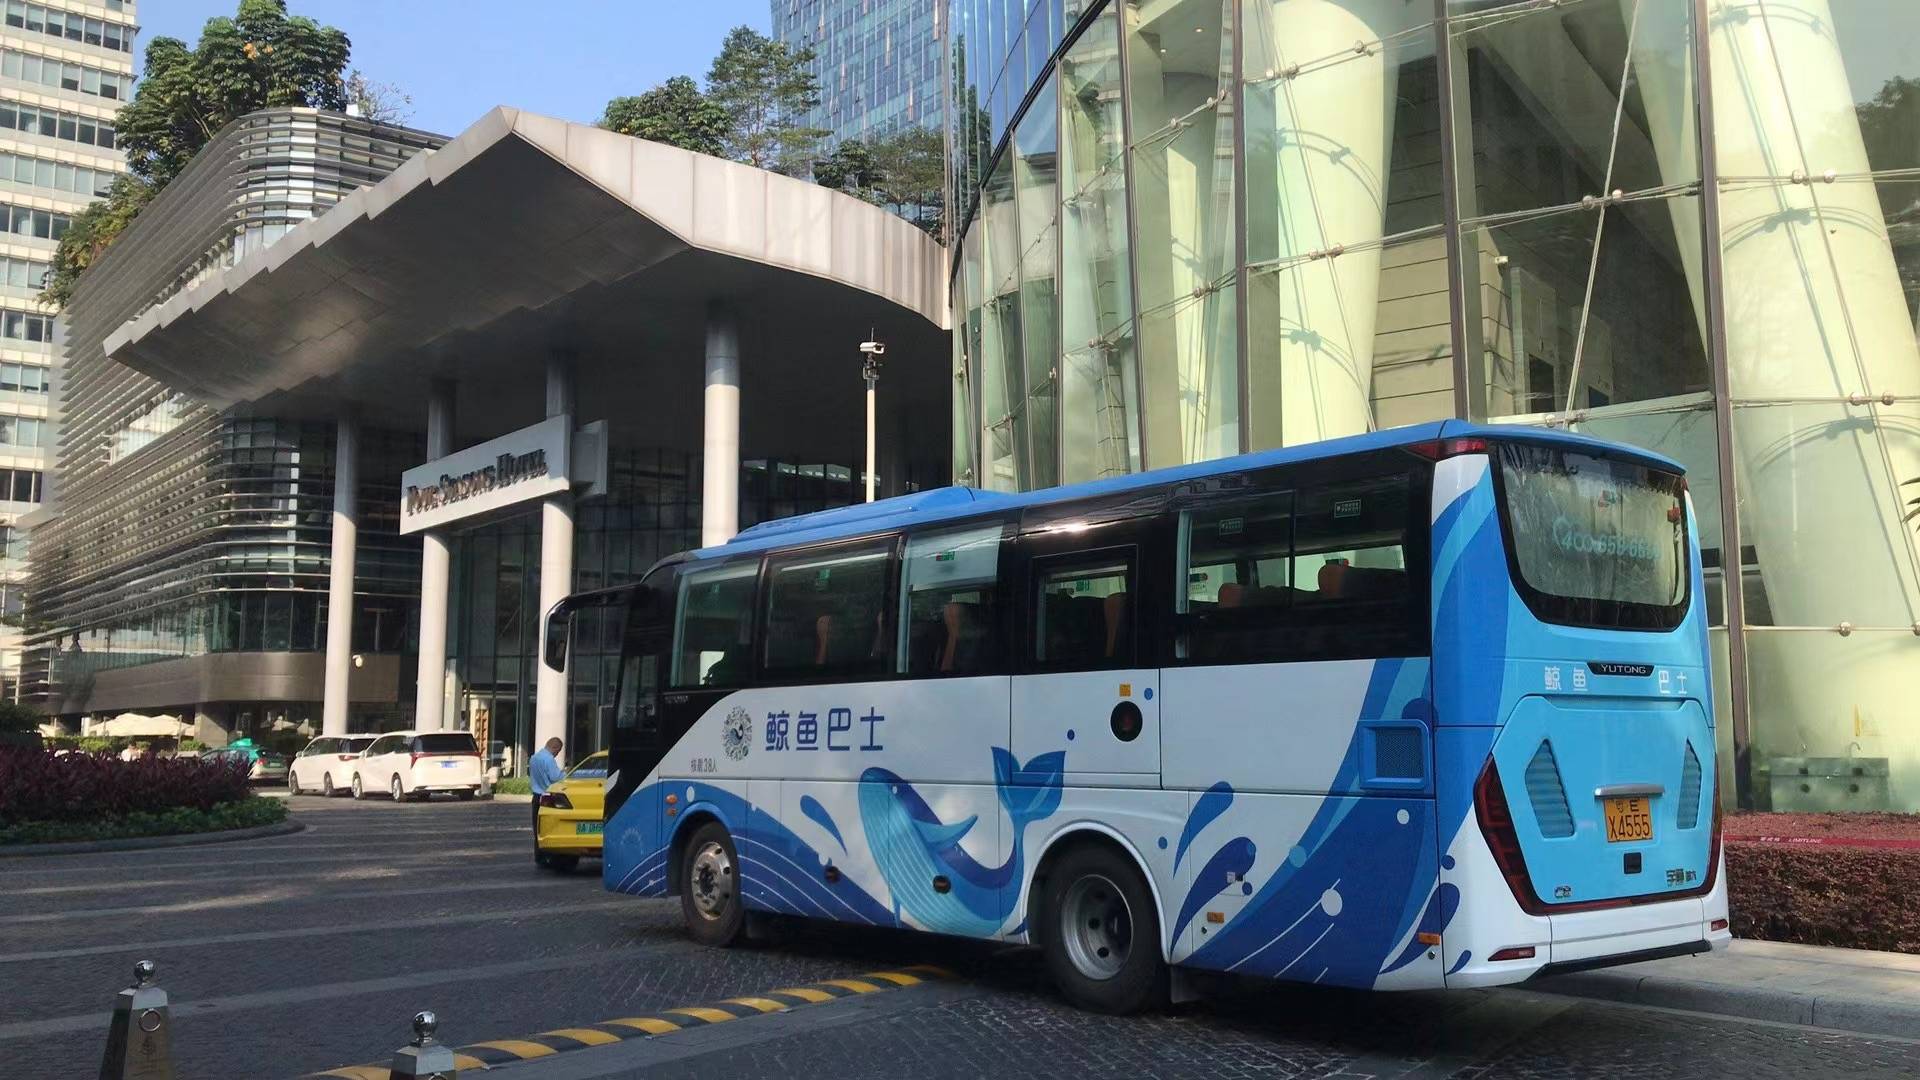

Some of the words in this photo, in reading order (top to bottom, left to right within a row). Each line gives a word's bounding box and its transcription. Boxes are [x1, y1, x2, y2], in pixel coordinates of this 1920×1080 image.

[1600, 664, 1647, 674] YUTONG
[765, 706, 885, 751] 鲸鱼巴士
[1608, 814, 1650, 839] X4555
